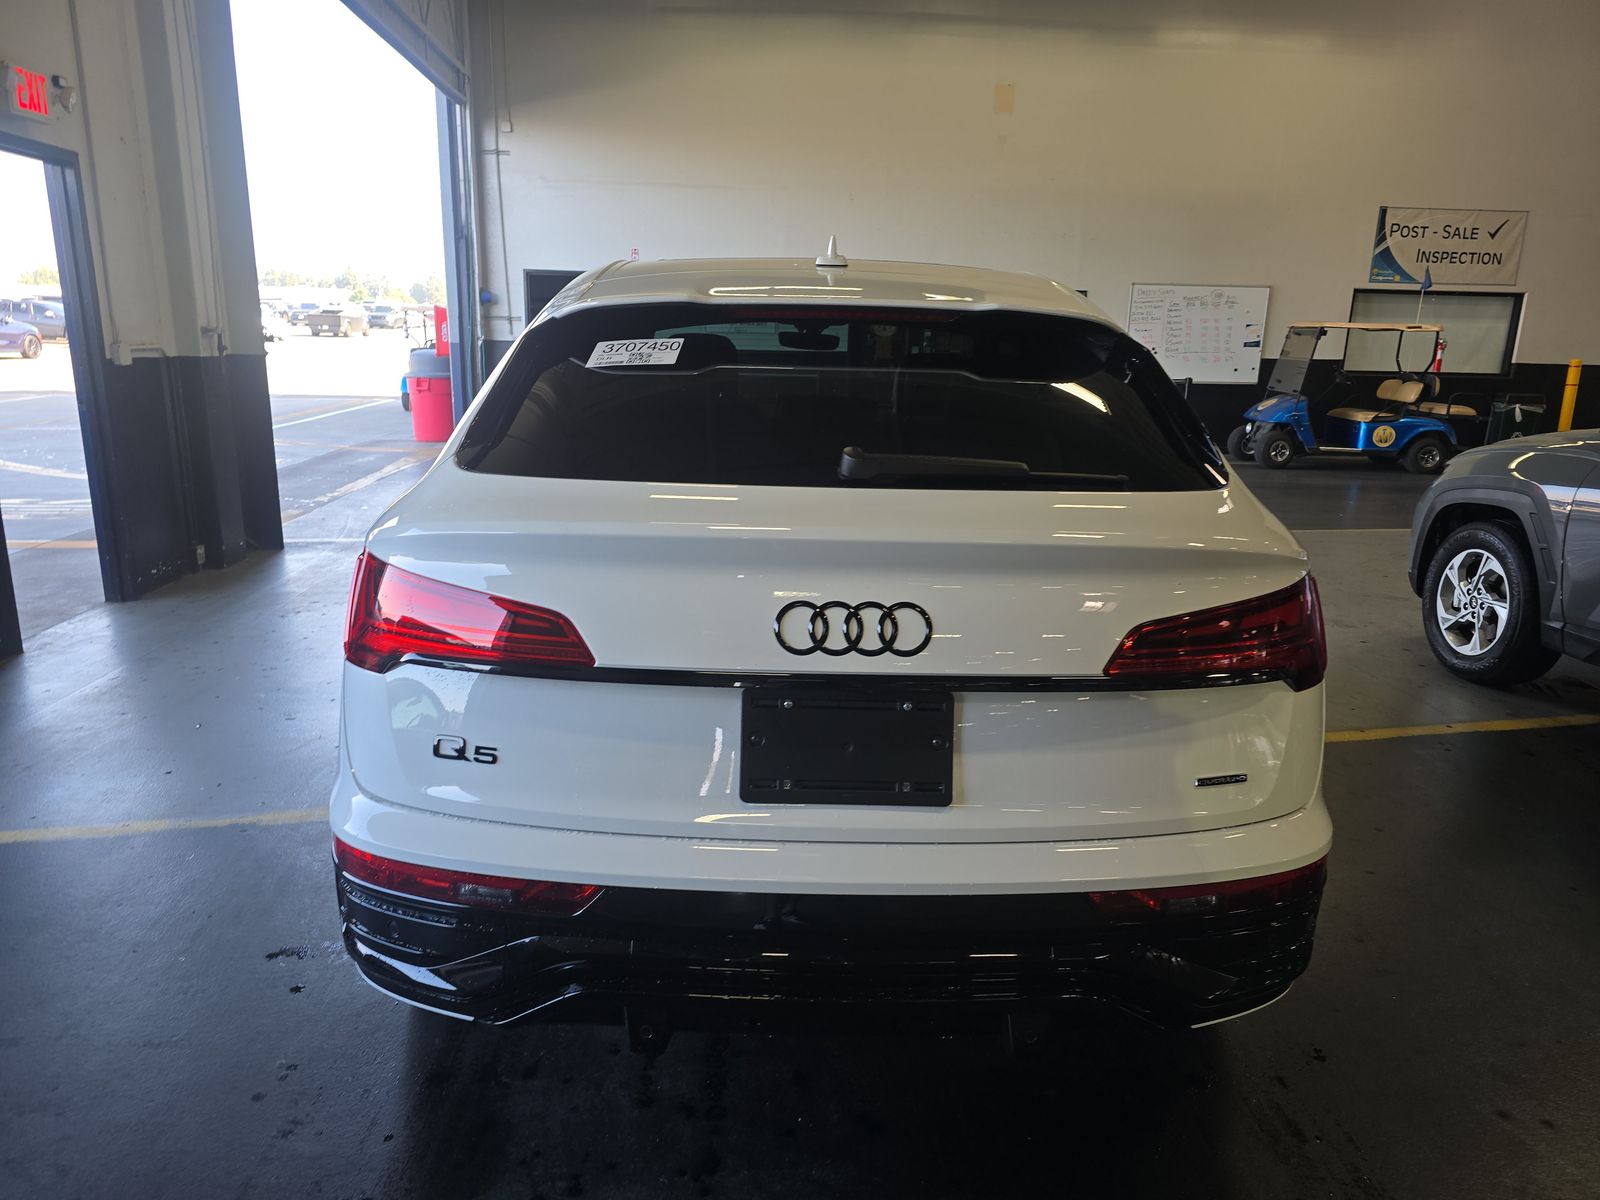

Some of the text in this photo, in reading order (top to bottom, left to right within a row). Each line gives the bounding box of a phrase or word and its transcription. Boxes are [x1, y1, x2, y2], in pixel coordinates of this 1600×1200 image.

[15, 66, 48, 116] EXIT
[1389, 223, 1429, 239] POST
[1442, 224, 1480, 240] SALE
[1415, 248, 1503, 265] INSPECTION
[602, 341, 681, 354] 3707450
[433, 733, 498, 765] Q5
